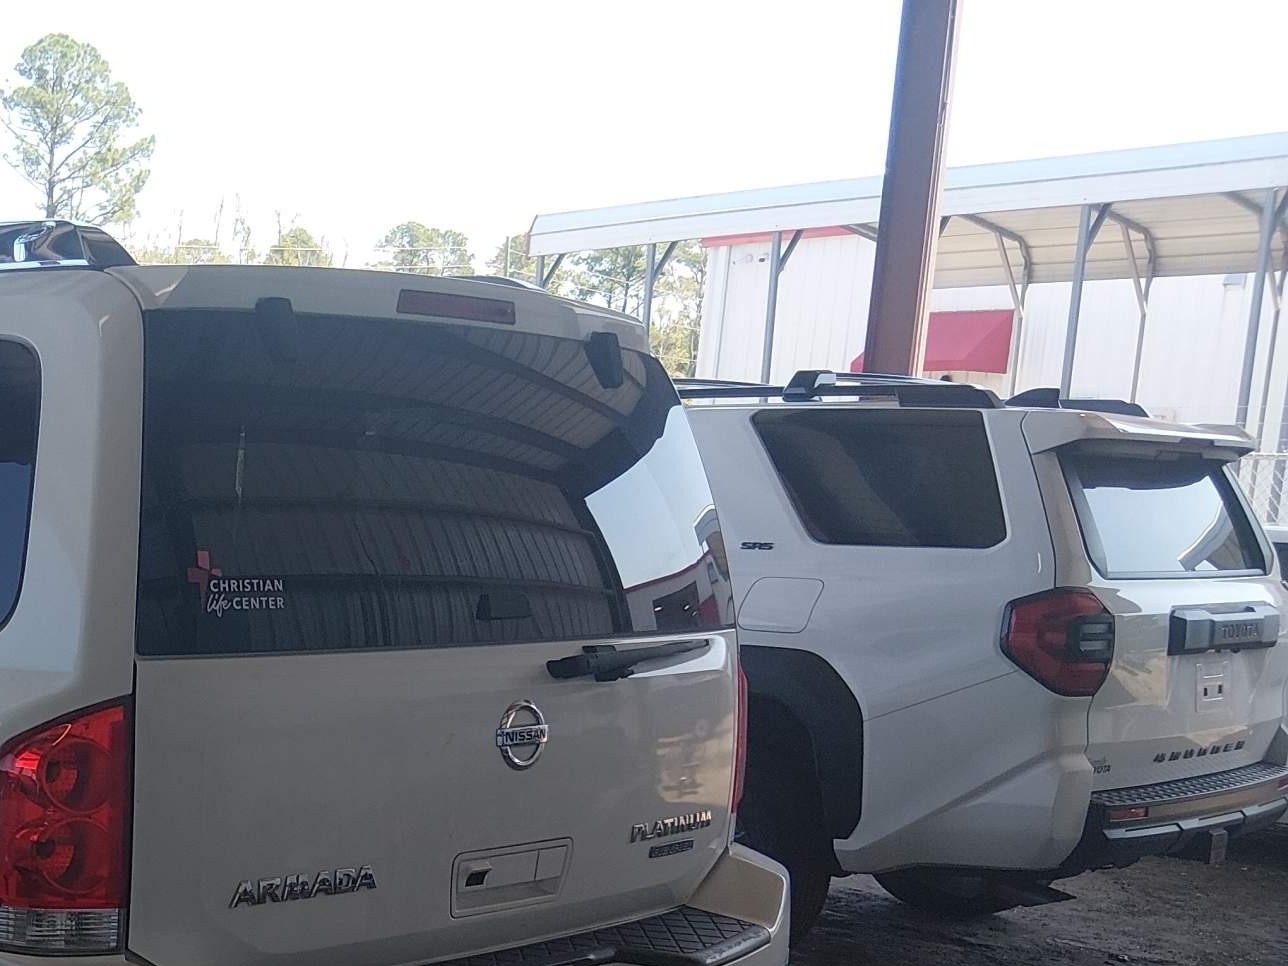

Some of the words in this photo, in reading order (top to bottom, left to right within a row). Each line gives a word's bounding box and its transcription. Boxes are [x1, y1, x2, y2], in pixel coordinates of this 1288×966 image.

[209, 579, 284, 592] CHRISTIAN
[206, 593, 232, 618] life
[232, 597, 285, 610] CENTER
[1221, 622, 1260, 640] TOYOTA
[505, 727, 546, 743] NISSAN
[629, 809, 712, 843] PLATINUM
[228, 864, 378, 909] ARMADA
